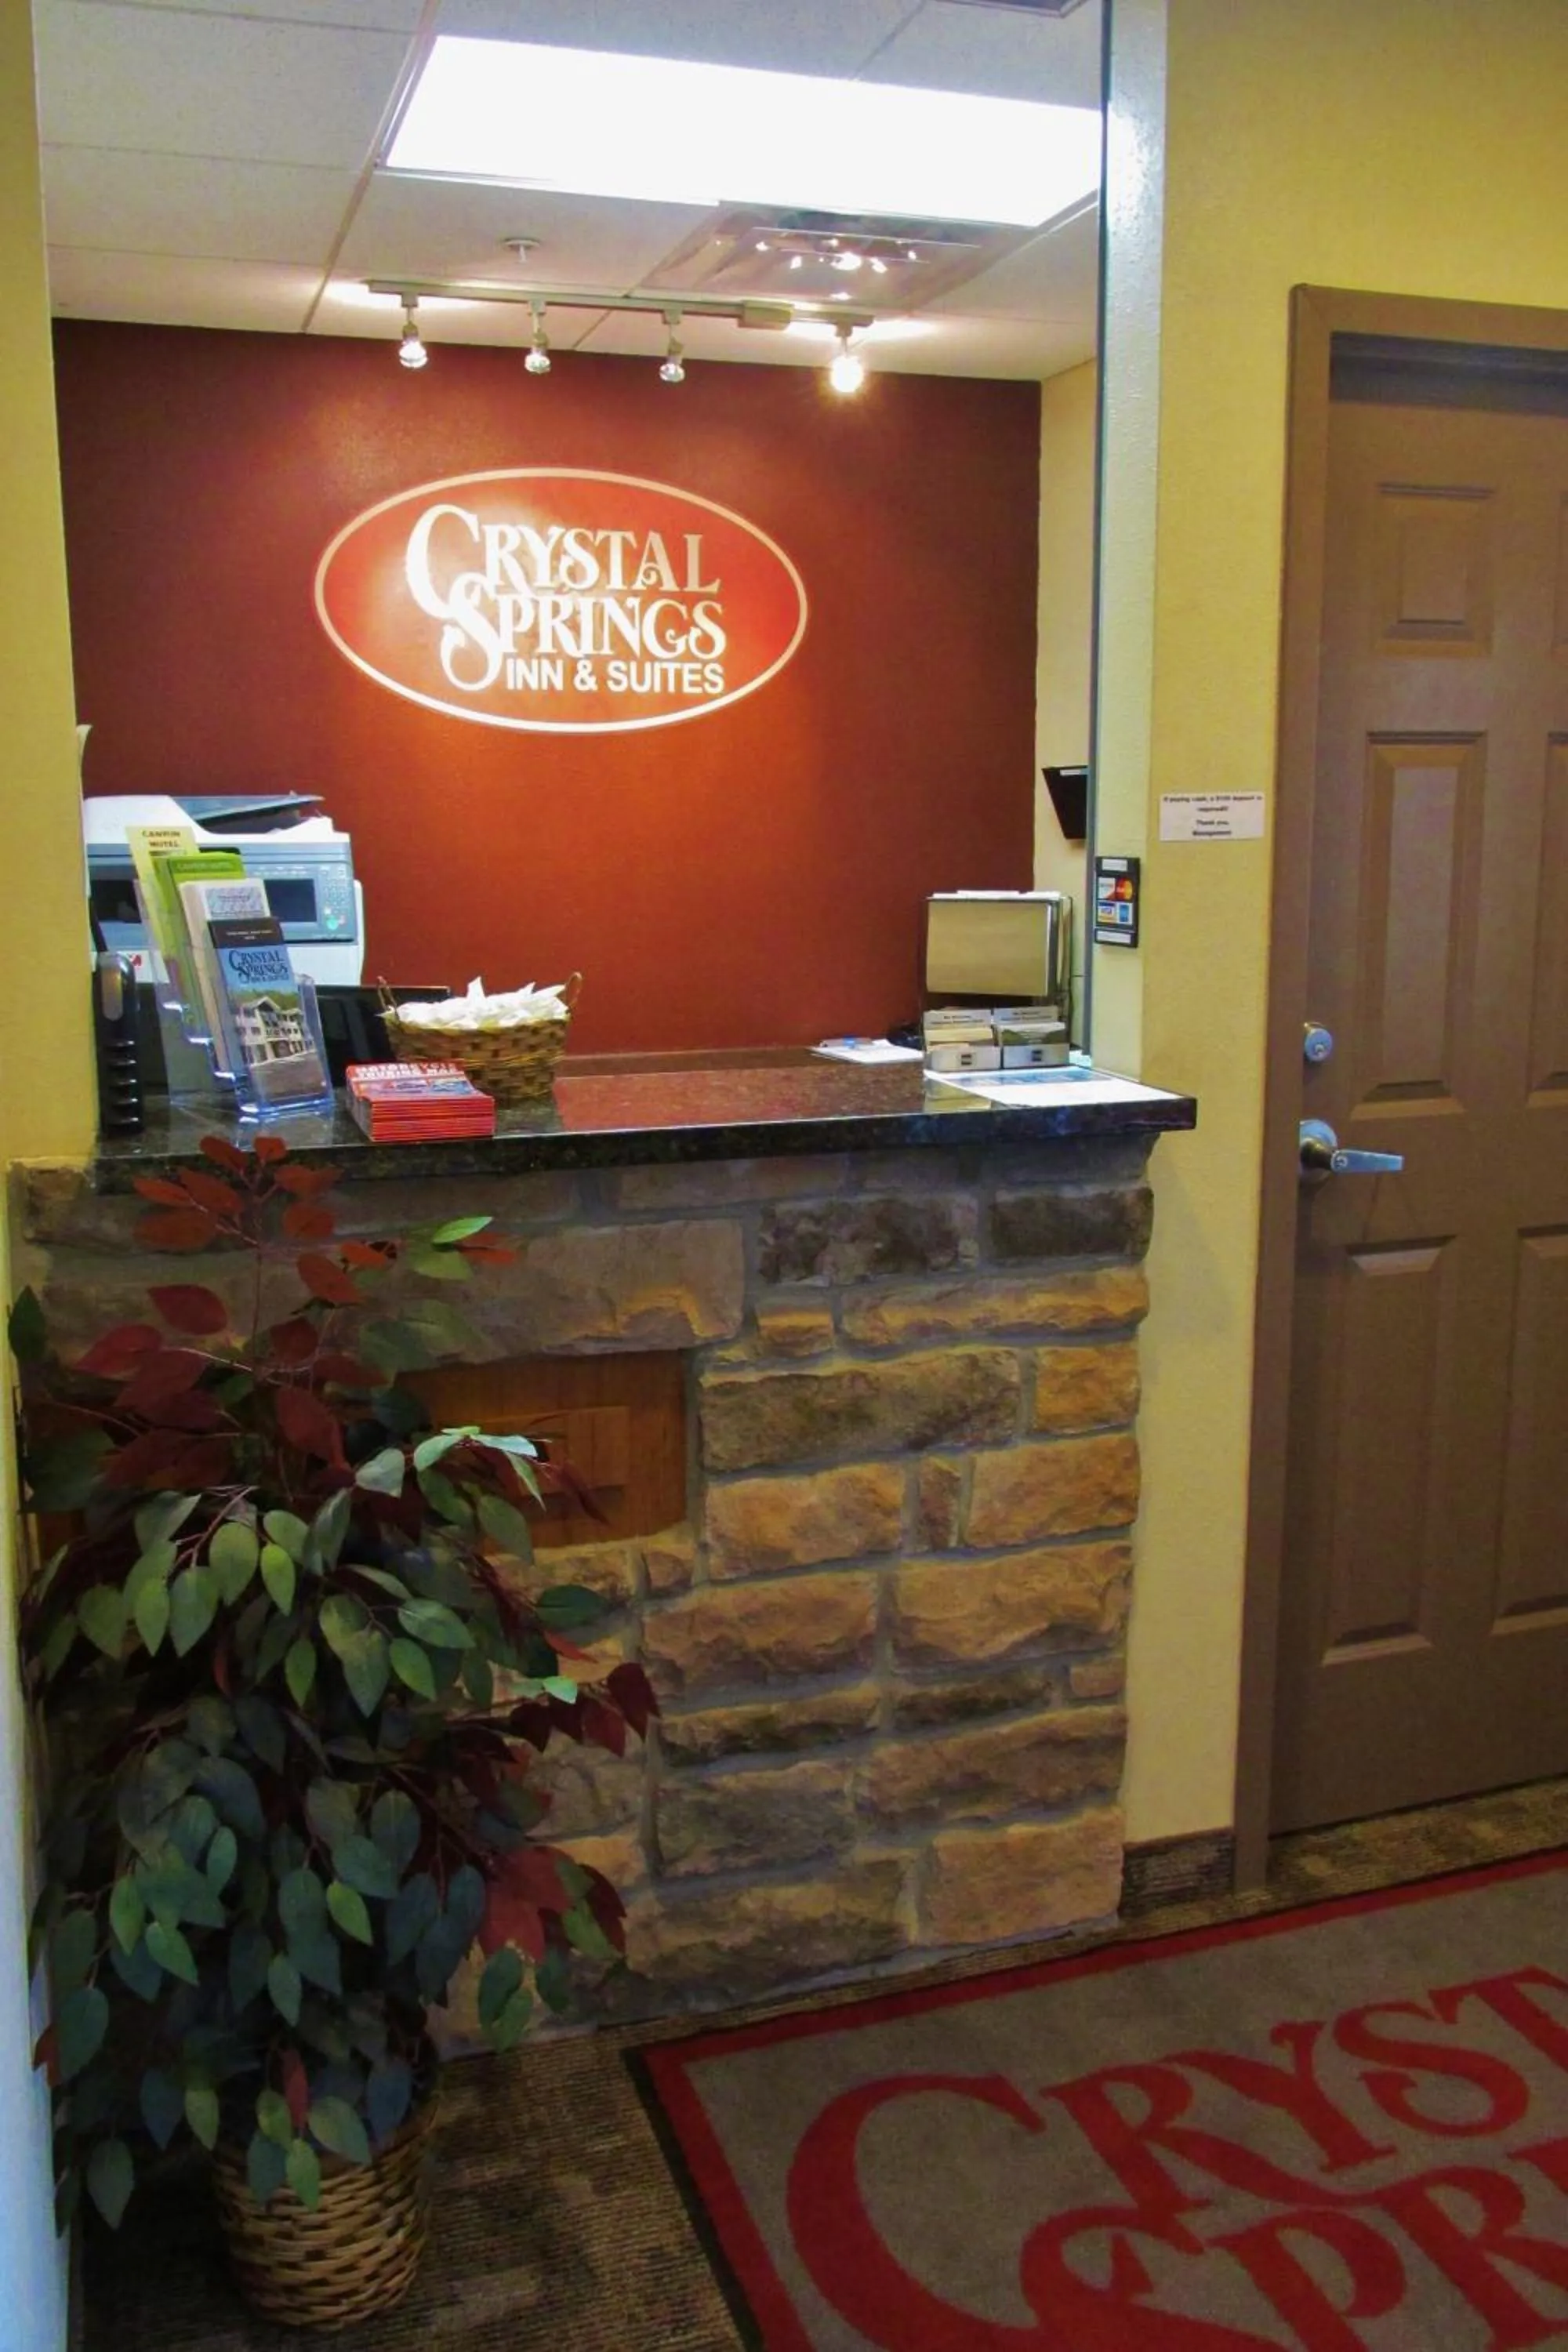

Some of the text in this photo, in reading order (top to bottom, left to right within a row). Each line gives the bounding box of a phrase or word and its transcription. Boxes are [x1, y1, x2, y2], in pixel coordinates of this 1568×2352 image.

[405, 503, 721, 619] CRYSTAL
[440, 572, 727, 691] SPRINGS
[506, 659, 725, 694] INN & SUITES
[228, 949, 285, 971] CRYSTAL
